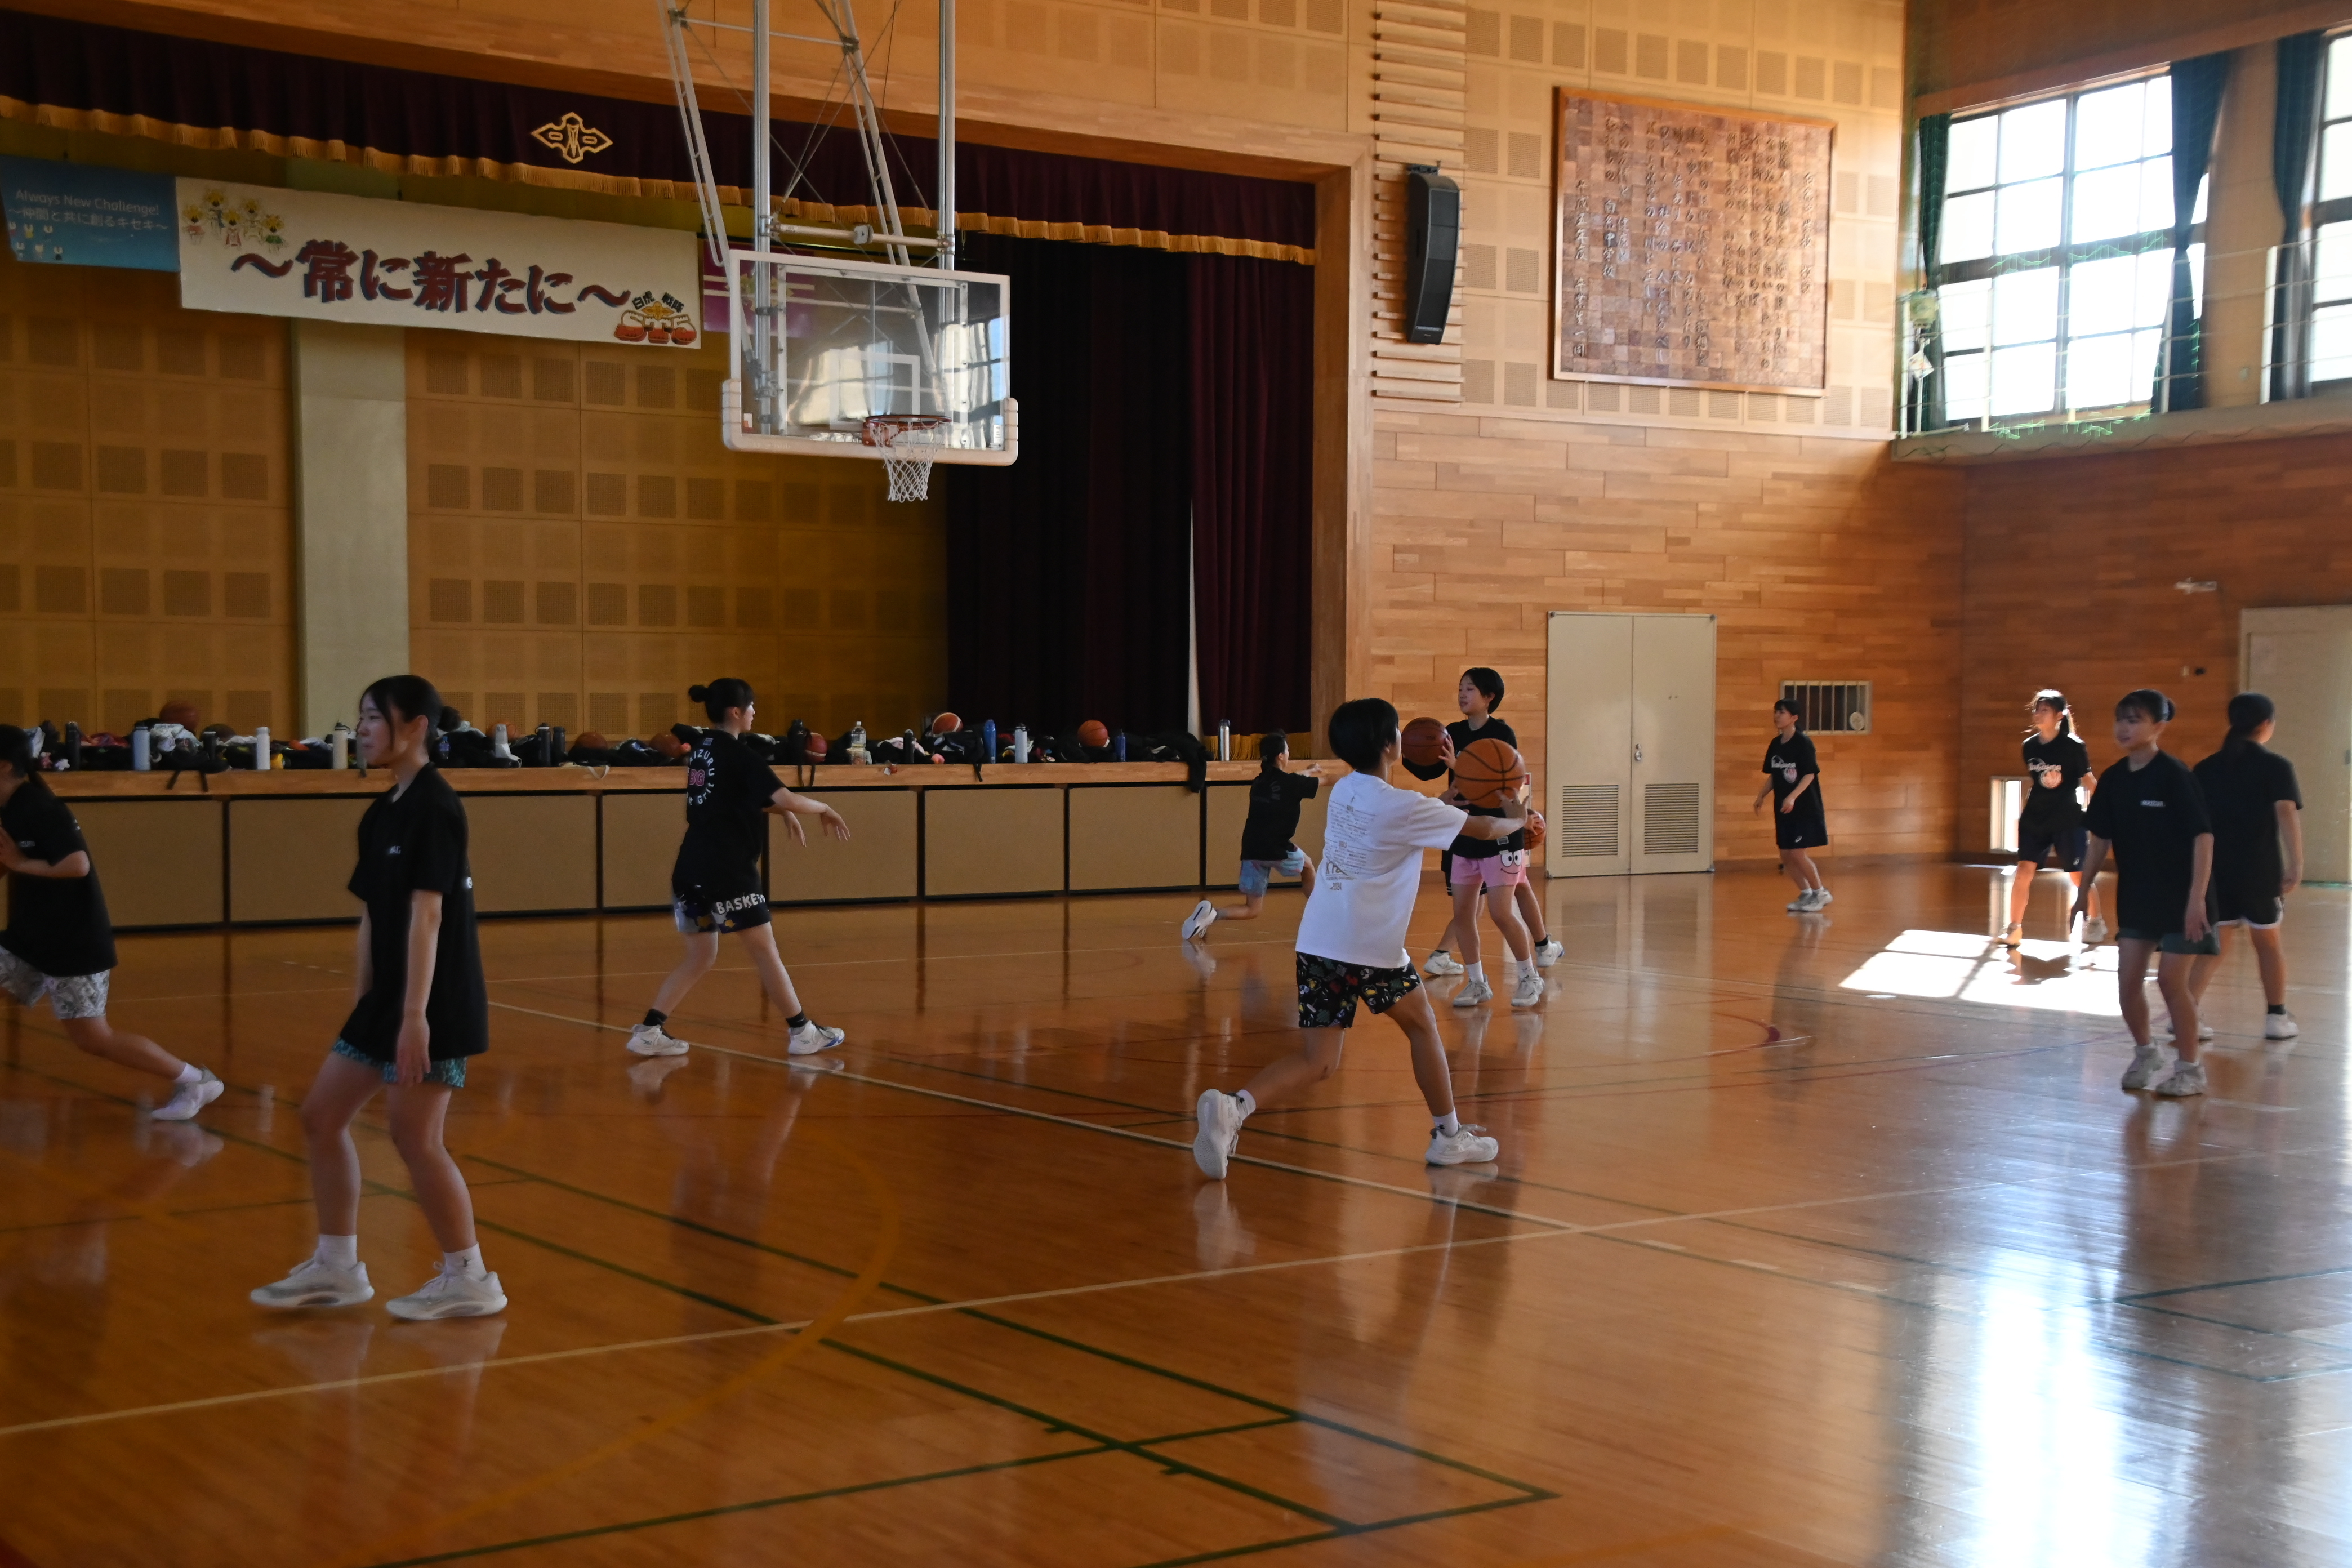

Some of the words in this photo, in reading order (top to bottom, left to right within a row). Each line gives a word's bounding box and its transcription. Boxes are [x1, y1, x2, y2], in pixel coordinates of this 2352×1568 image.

[16, 189, 60, 206] Always
[64, 194, 91, 208] New
[95, 198, 159, 217] Challenge!
